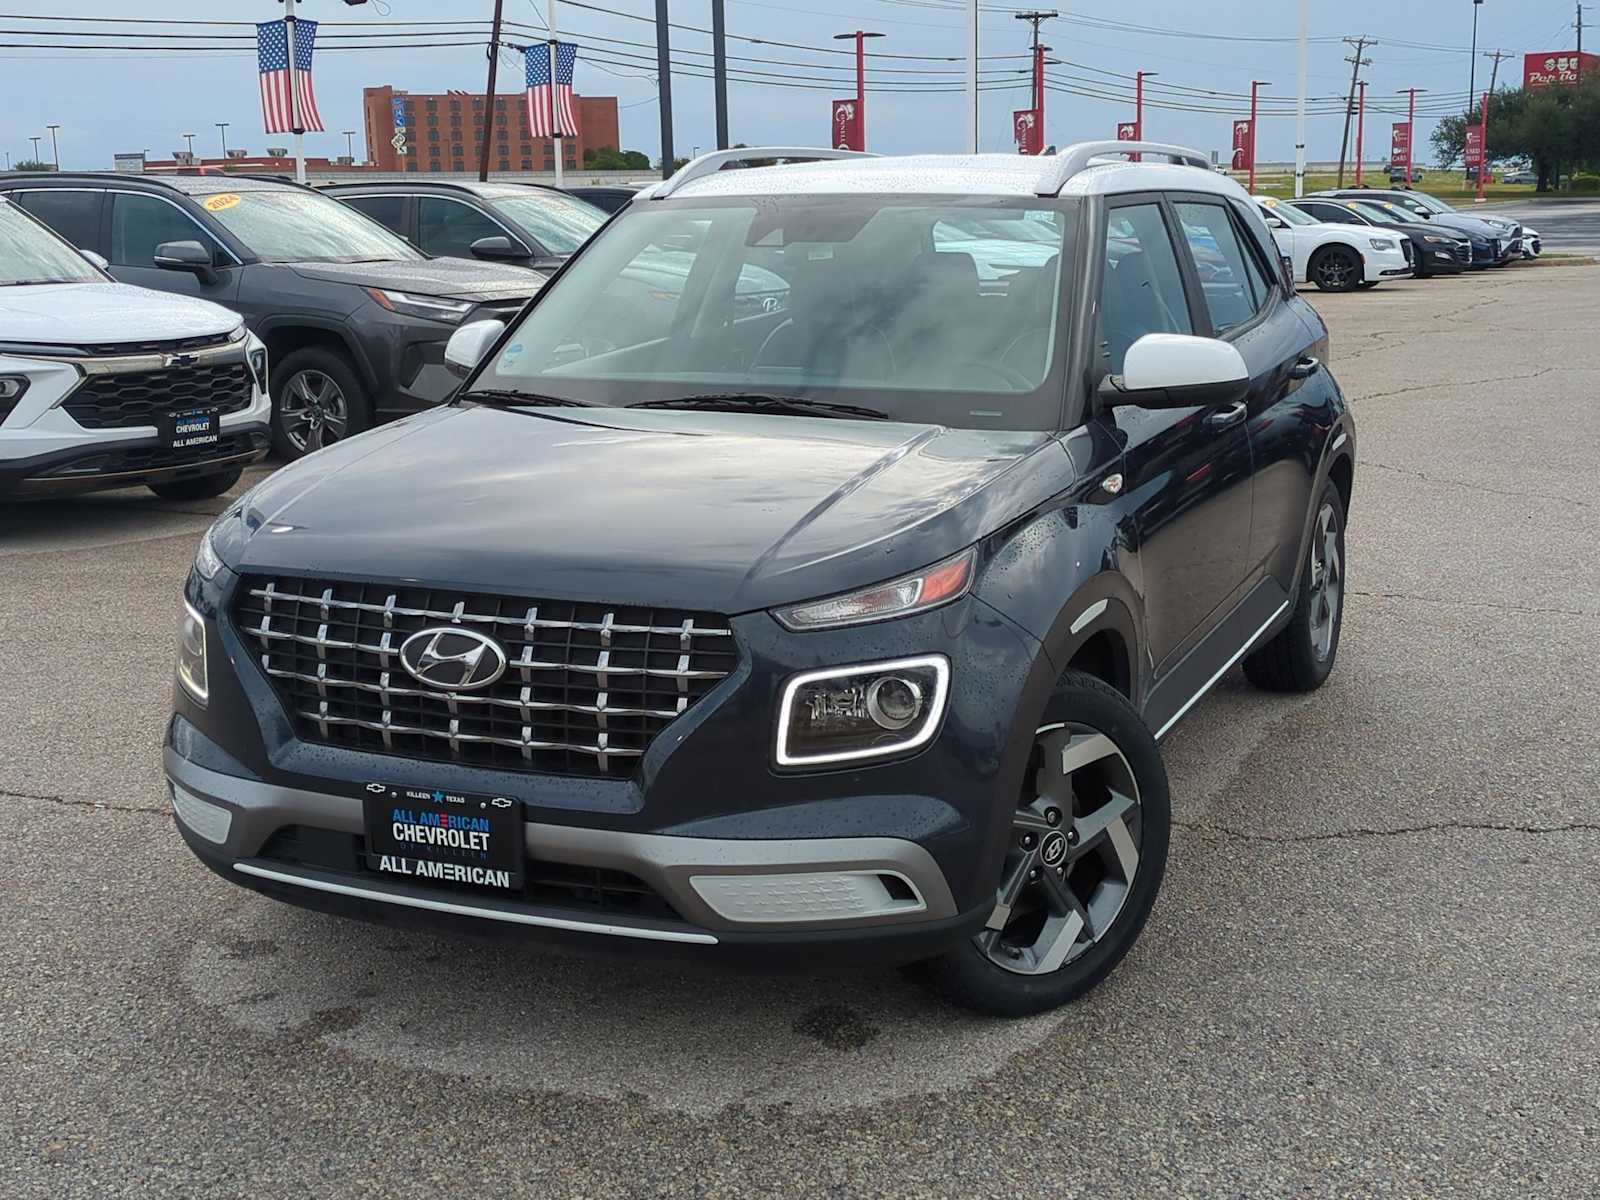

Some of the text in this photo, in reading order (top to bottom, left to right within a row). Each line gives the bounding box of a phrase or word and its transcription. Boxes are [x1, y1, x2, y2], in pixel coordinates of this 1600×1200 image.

[1559, 70, 1579, 82] Bo
[176, 423, 209, 433] CHEVROLET
[186, 435, 217, 446] AMERICAN
[406, 791, 465, 804] KILLEEN TEXAS
[392, 808, 489, 832] ALL AMERICAN
[392, 822, 490, 851] CHEVROLET
[379, 855, 510, 889] ALL AMERICAN
